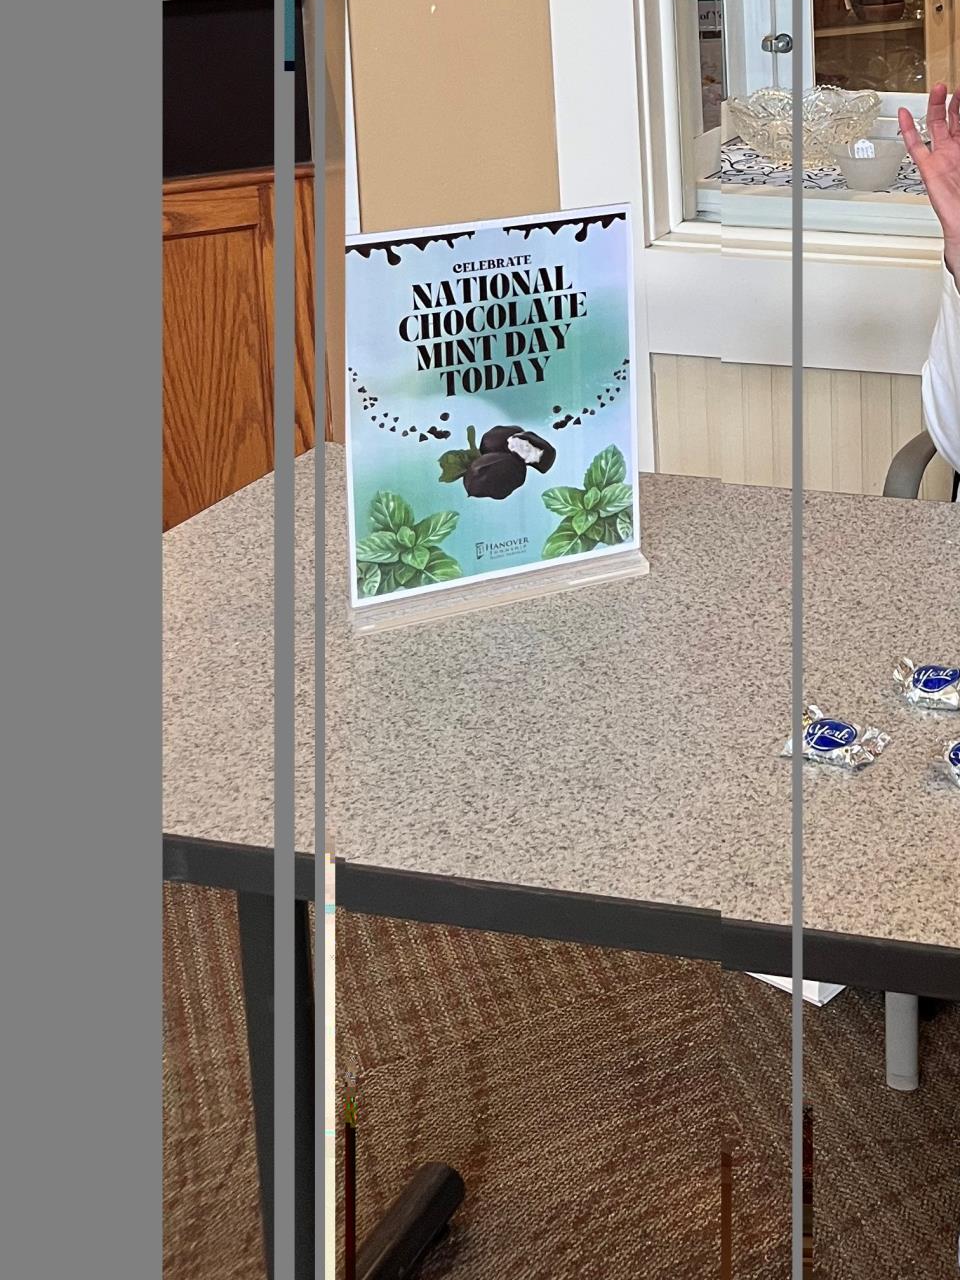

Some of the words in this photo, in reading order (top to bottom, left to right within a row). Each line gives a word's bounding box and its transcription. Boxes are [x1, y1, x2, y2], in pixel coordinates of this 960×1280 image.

[452, 254, 532, 274] CELEBRATE
[412, 265, 573, 311] NATIONAL
[398, 291, 588, 343] CHOCOLATE
[416, 334, 498, 371] MINT
[504, 323, 572, 358] DAY
[440, 355, 551, 397] TODAY
[485, 537, 529, 551] HANOVER
[914, 668, 953, 690] York
[806, 724, 850, 747] York
